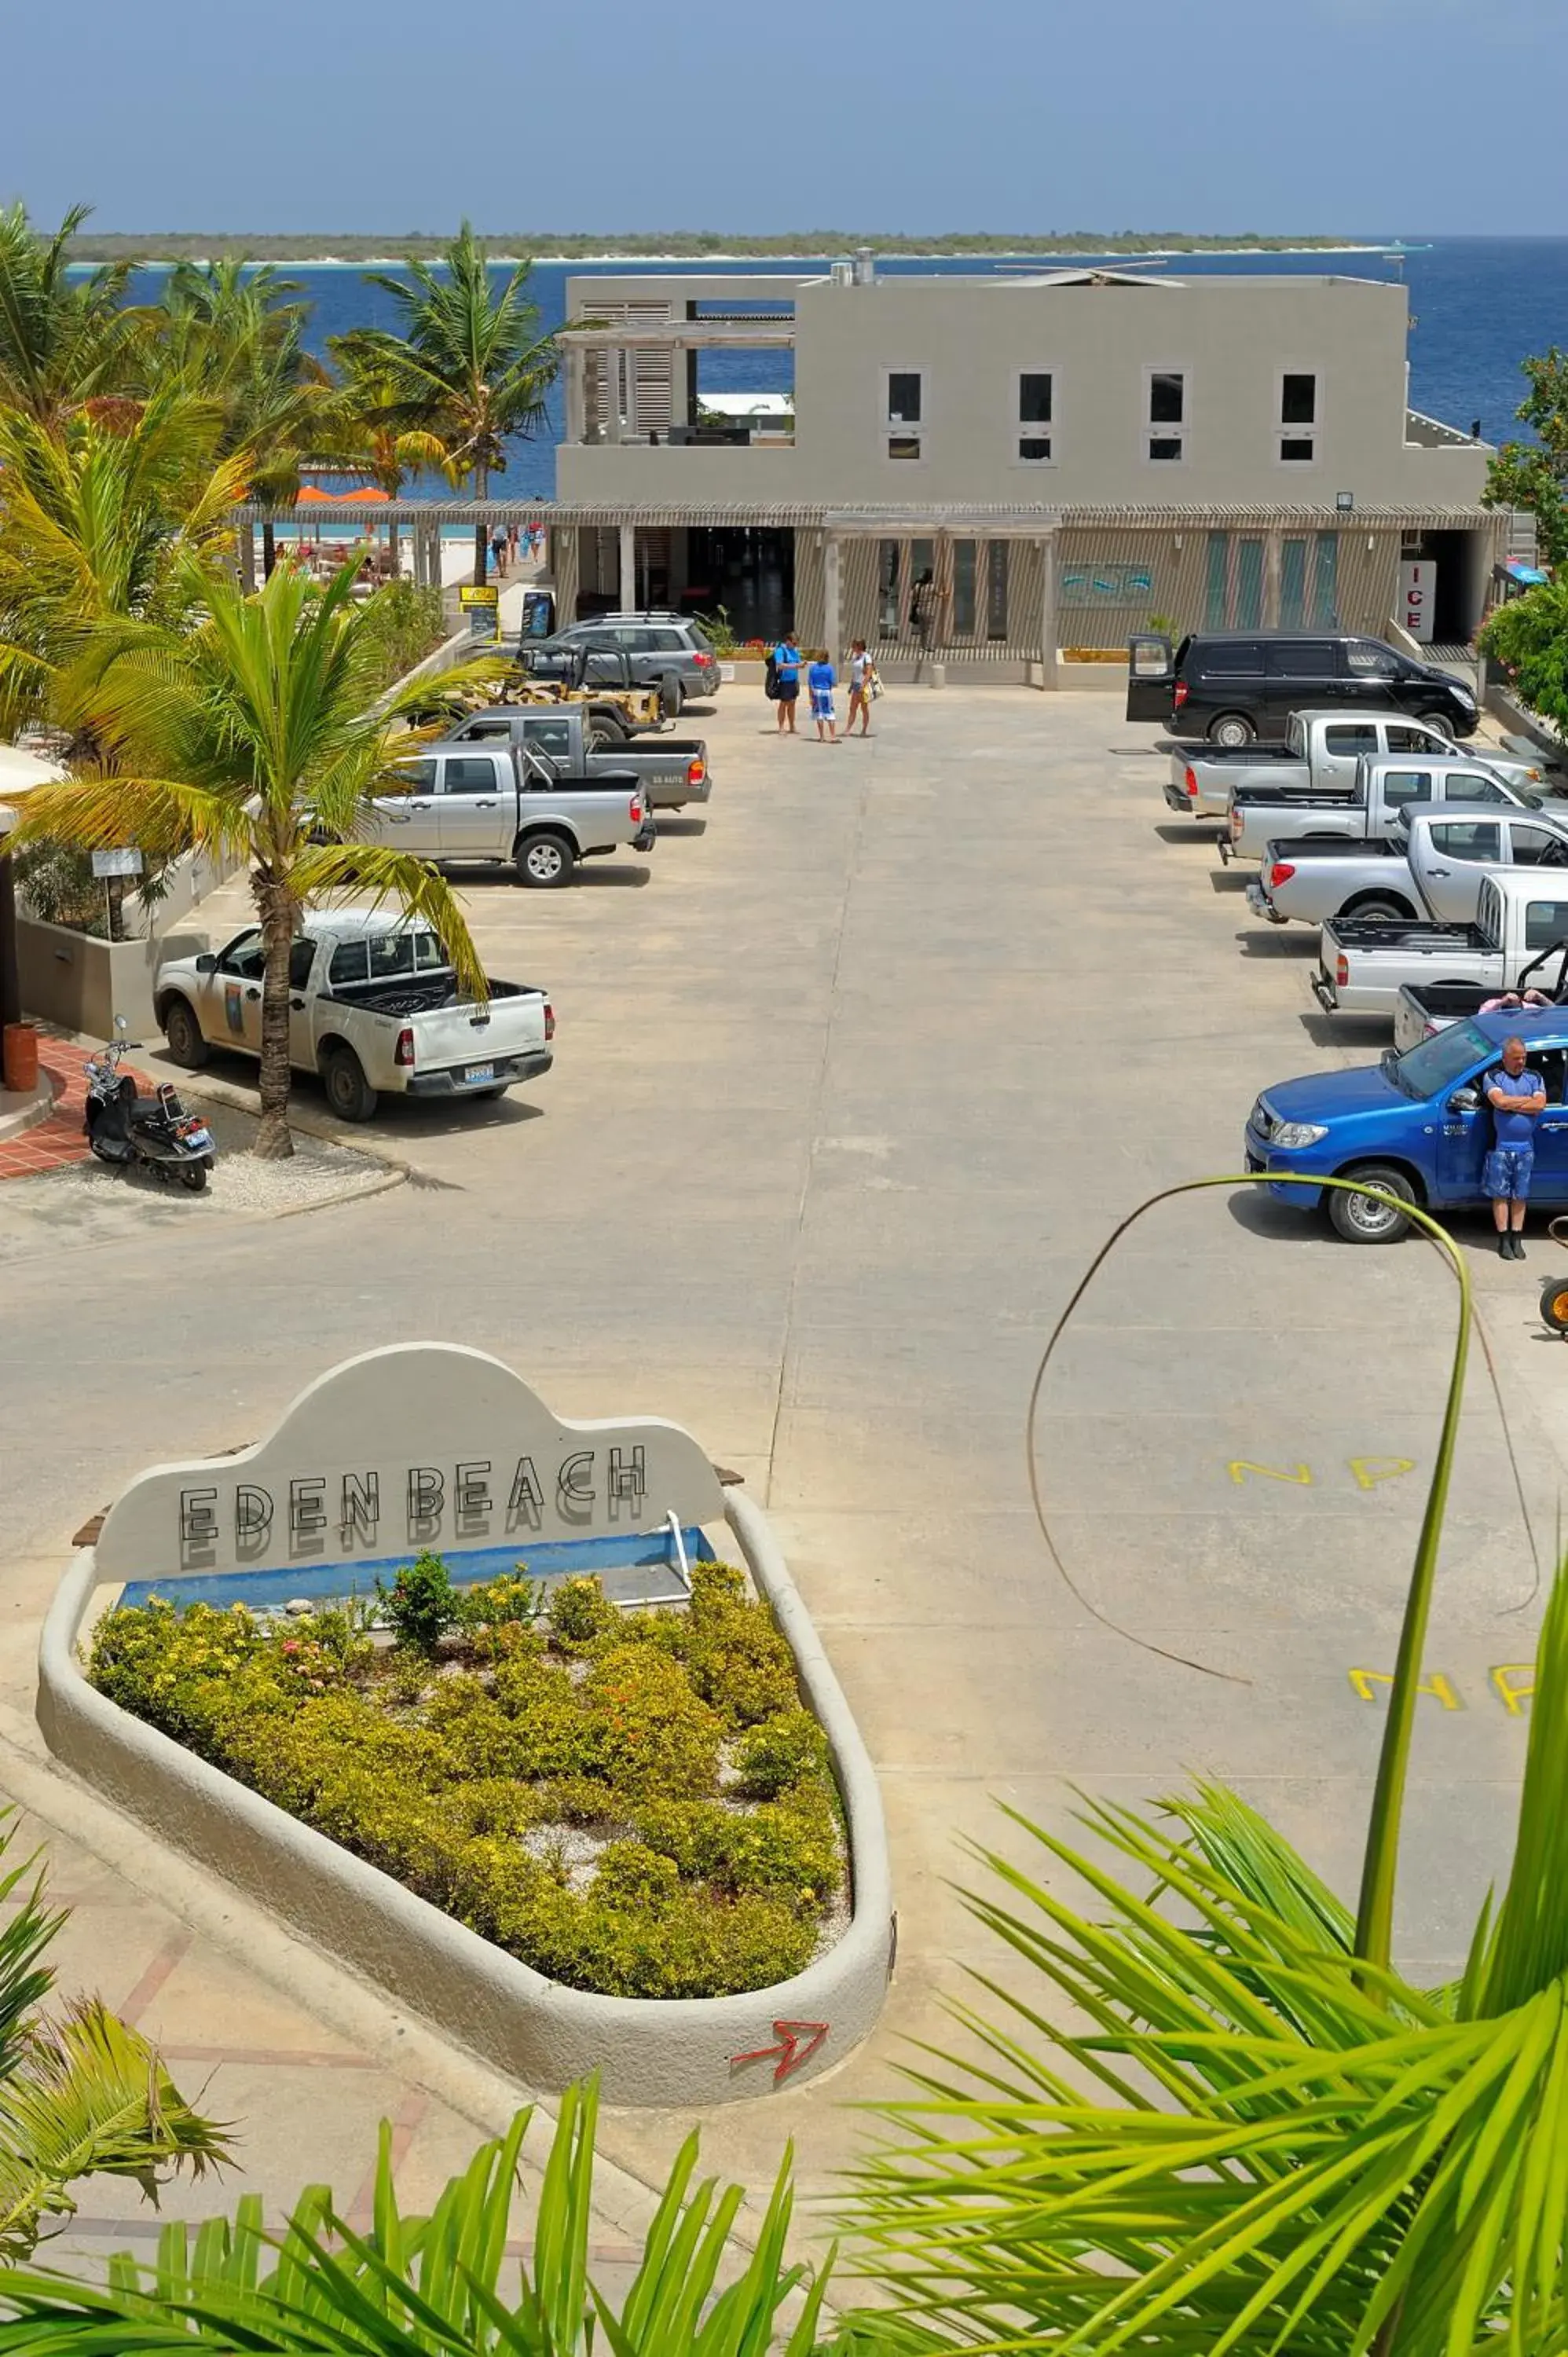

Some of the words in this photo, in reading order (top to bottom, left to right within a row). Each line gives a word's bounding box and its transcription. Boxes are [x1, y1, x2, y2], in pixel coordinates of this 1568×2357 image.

[1407, 566, 1423, 628] ICE
[180, 1472, 380, 1541] EDEN
[408, 1445, 646, 1519] BEACH
